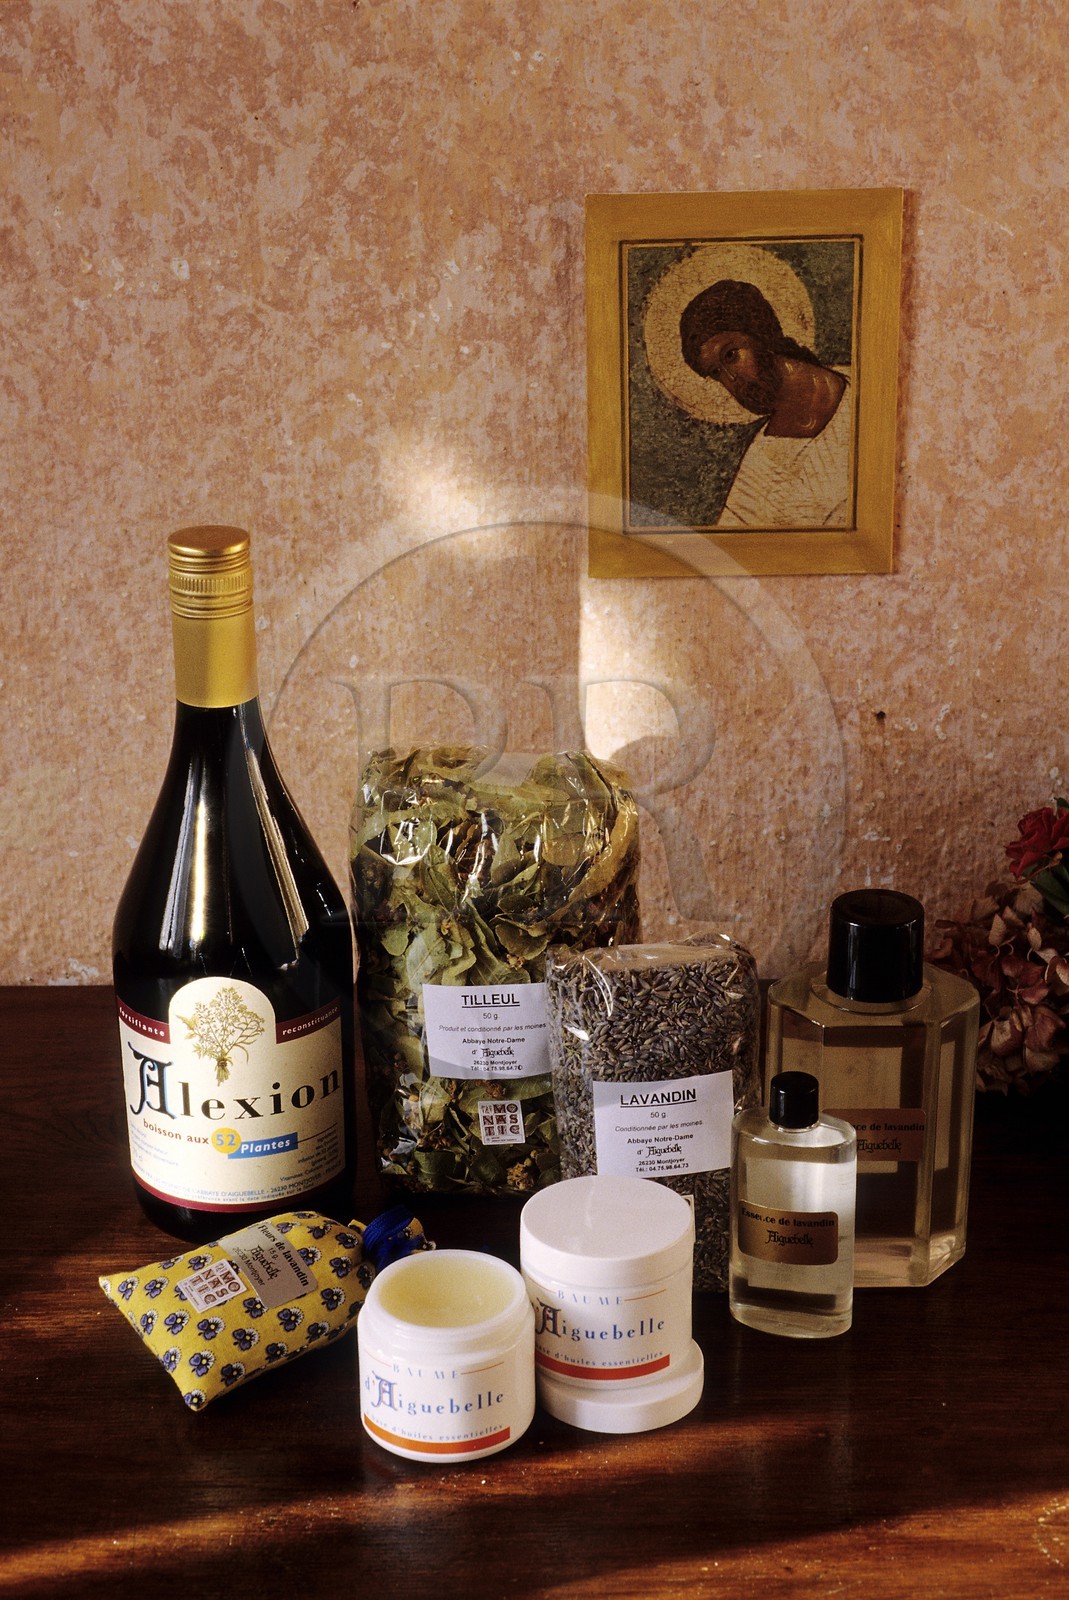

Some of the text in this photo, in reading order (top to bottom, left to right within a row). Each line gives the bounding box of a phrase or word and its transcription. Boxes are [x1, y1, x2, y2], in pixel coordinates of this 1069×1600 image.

[461, 993, 520, 1006] TILLEUL
[119, 1007, 165, 1038] fortifiante
[281, 1006, 339, 1036] reconstituante
[482, 1012, 491, 1020] 50
[467, 1024, 501, 1032] conditionné
[127, 1041, 340, 1120] Alexion
[620, 1088, 696, 1106] LAVANDIN
[615, 1124, 656, 1132] Conditionnée
[870, 1123, 881, 1131] de
[884, 1123, 925, 1131] lavandin
[143, 1118, 182, 1140] boisson
[186, 1135, 209, 1144] aux
[215, 1134, 236, 1146] 52
[241, 1139, 290, 1154] Plantes
[654, 1134, 693, 1142] Notre-Dame
[646, 1143, 682, 1158] Aiguebelle
[778, 1217, 790, 1226] de
[793, 1219, 835, 1228] lavandin
[765, 1229, 814, 1248] Aiguebelle
[257, 1224, 309, 1287] Fleurs de lavandin
[558, 1290, 622, 1305] BAUME
[554, 1352, 596, 1366] d'huiles
[602, 1351, 664, 1367] essentielles
[393, 1364, 458, 1379] BAUME
[364, 1371, 504, 1415] d'Aiguebelle
[391, 1426, 432, 1440] d'huiles
[439, 1424, 503, 1441] essentielles
